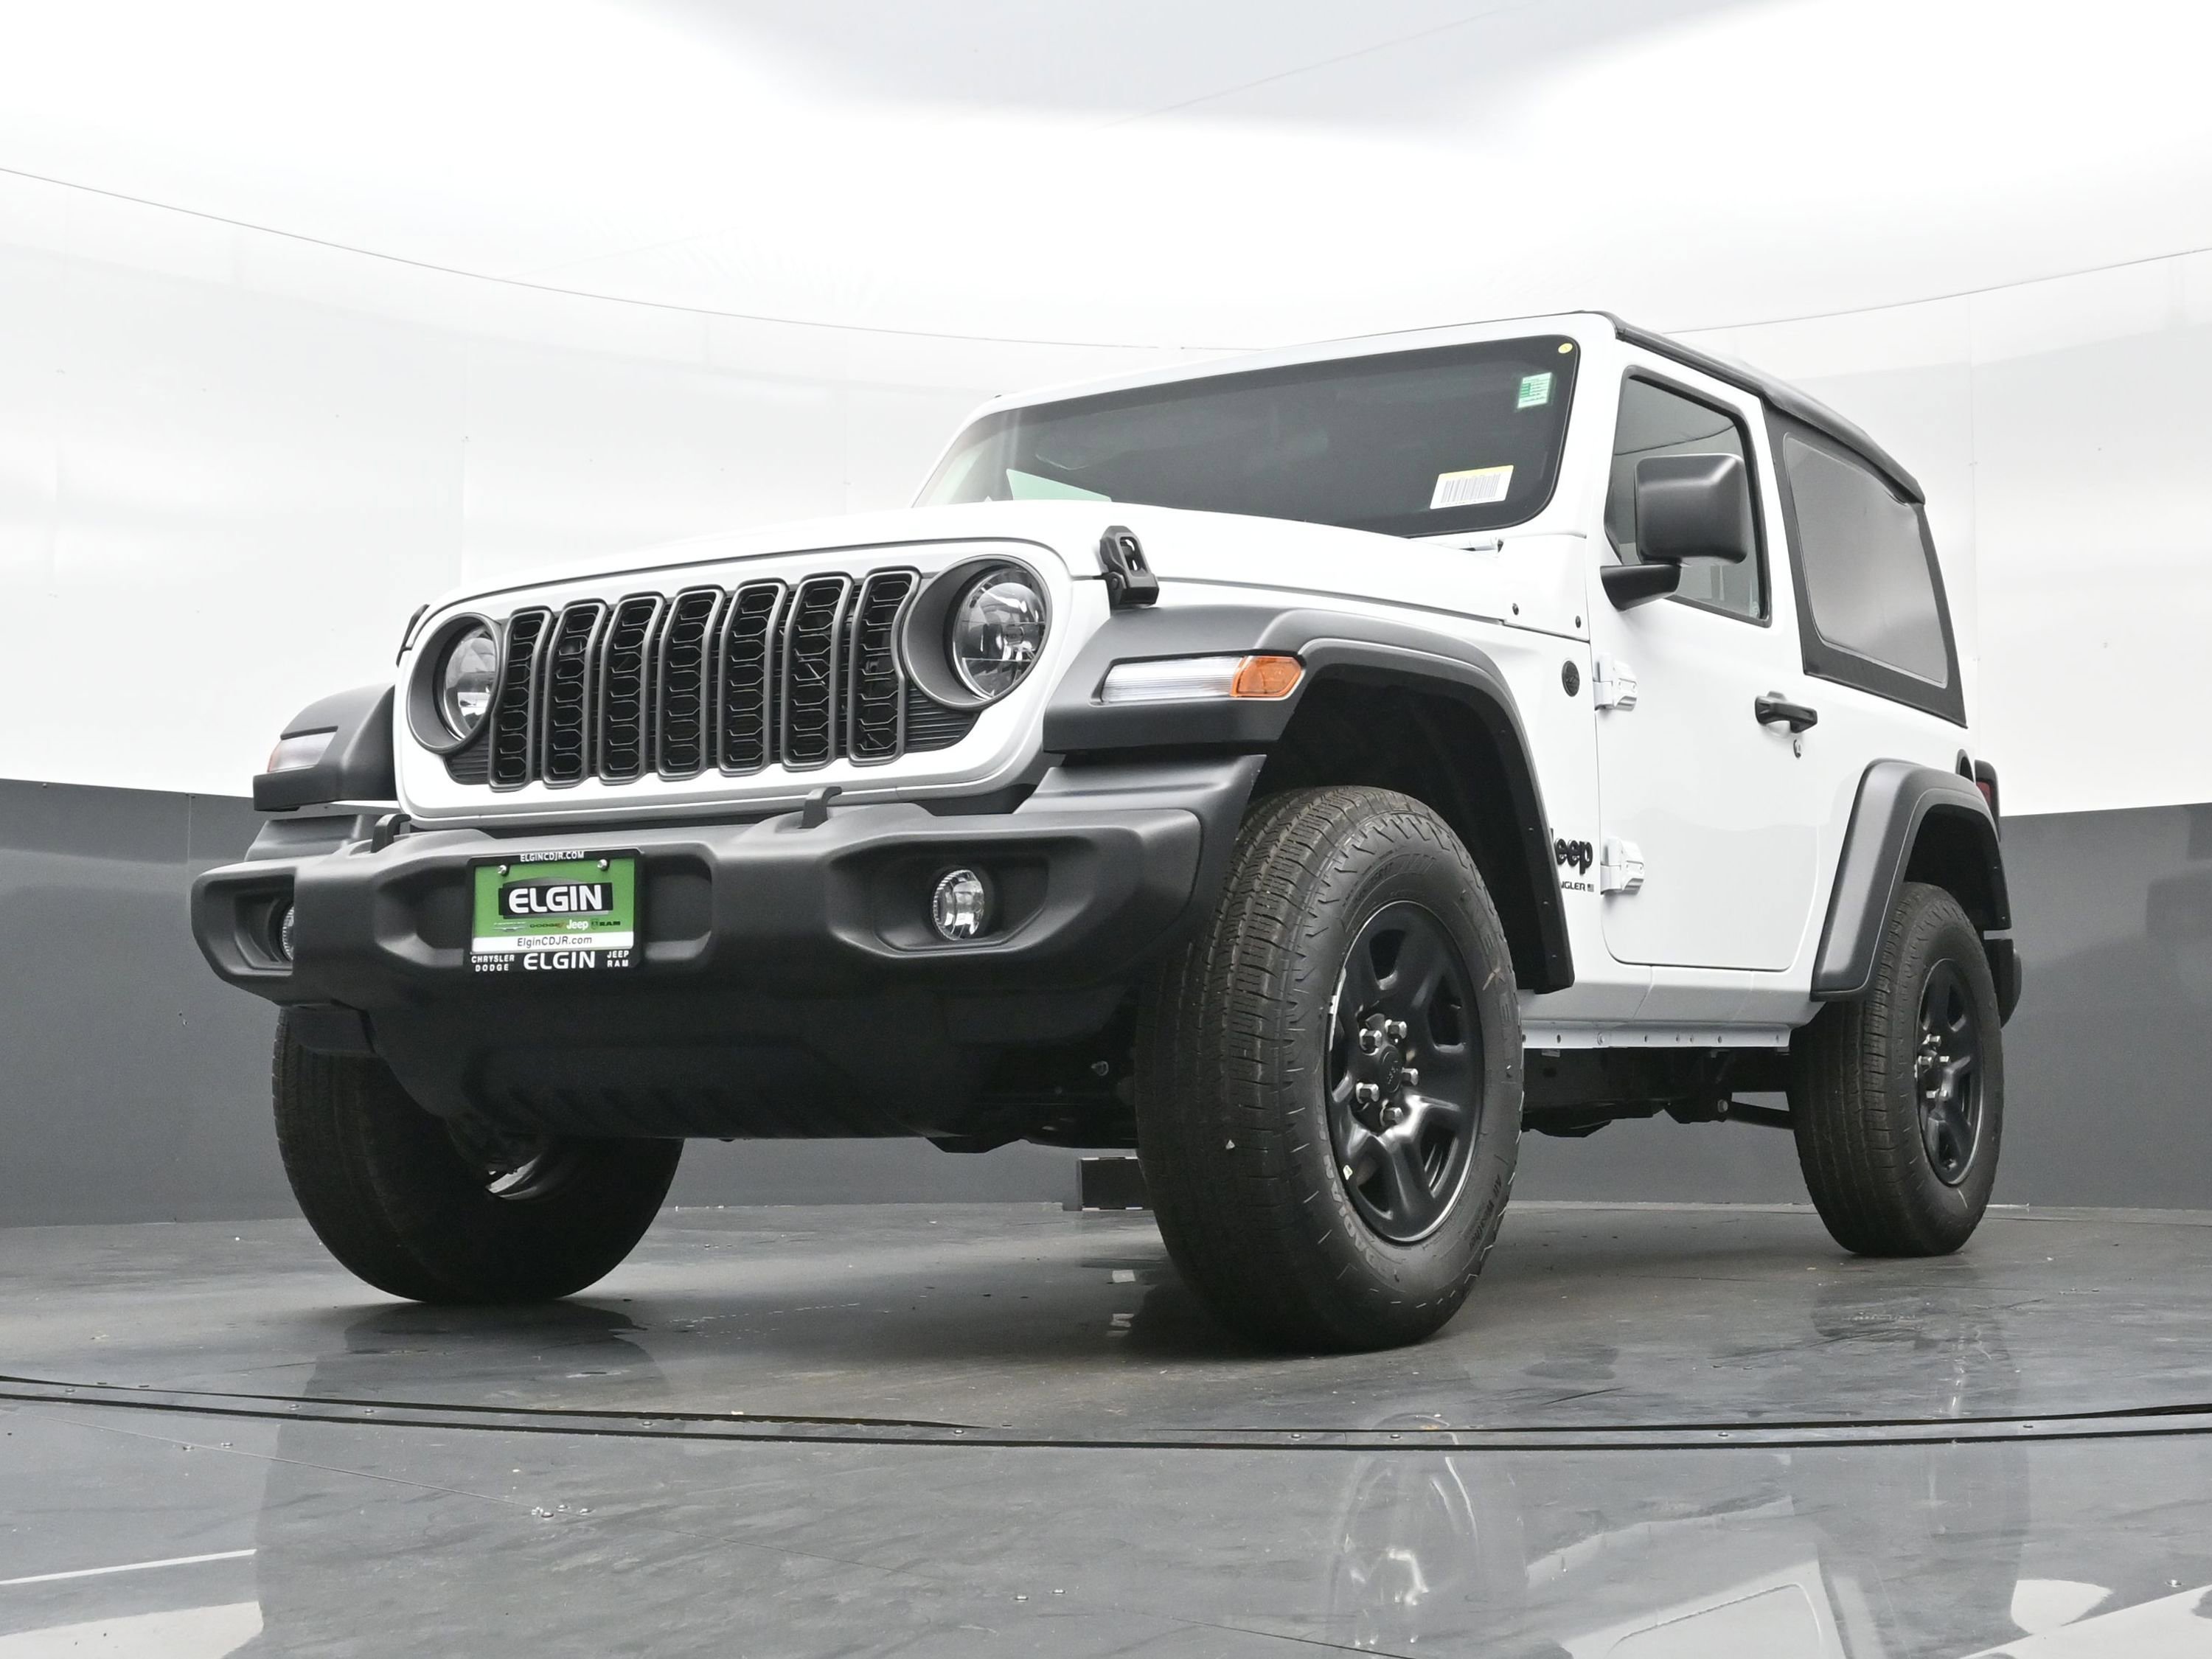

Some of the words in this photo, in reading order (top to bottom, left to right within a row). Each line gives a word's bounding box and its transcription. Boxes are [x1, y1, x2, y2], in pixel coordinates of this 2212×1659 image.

[520, 851, 585, 862] ELGINCDJR.COM
[508, 885, 603, 914] ELGIN
[566, 919, 588, 931] Jeep
[517, 936, 592, 949] ElginCDJR.com
[471, 955, 515, 964] CHRYSLER
[607, 950, 629, 959] JEEP
[524, 951, 596, 970] ELGIN
[475, 964, 509, 972] DODGE
